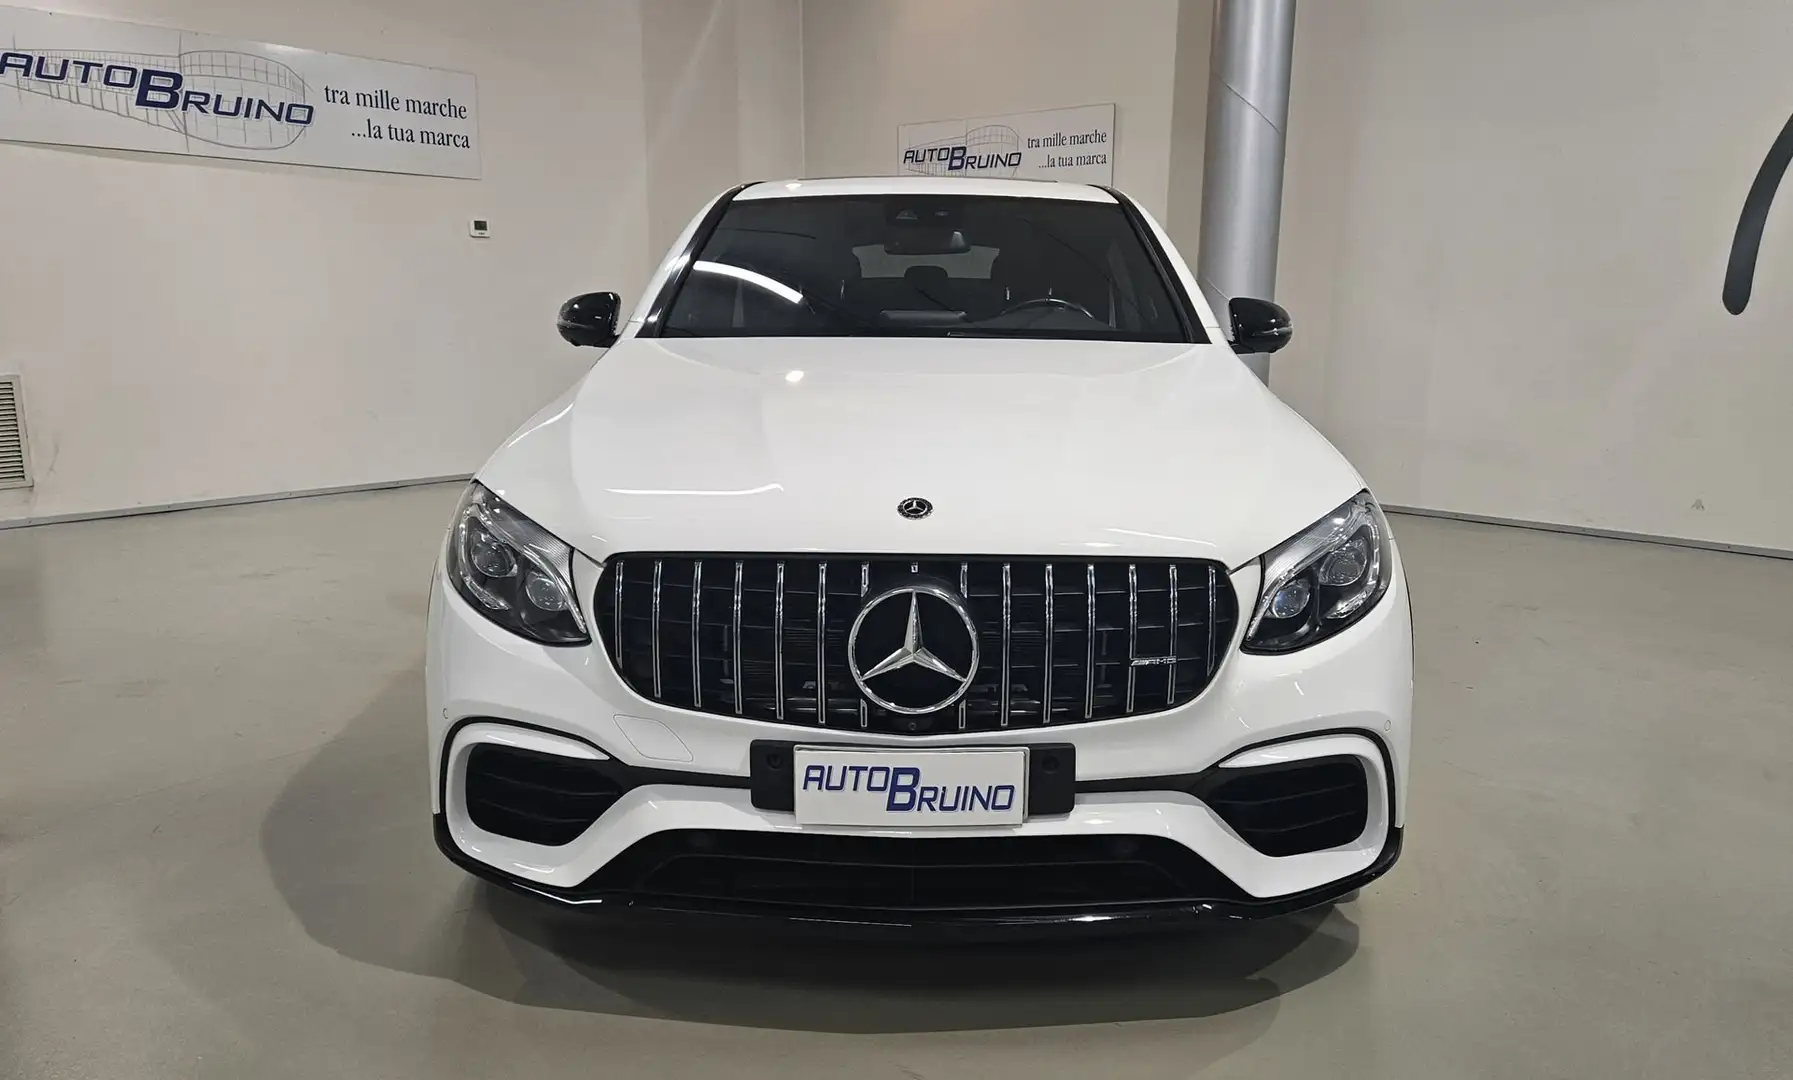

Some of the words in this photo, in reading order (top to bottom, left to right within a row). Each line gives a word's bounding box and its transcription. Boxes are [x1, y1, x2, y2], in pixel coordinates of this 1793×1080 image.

[324, 84, 350, 105] tra
[355, 89, 400, 111] mille
[405, 98, 468, 120] marche
[351, 118, 383, 140] ...la
[388, 123, 416, 143] tua
[420, 128, 471, 149] marca
[1027, 137, 1040, 149] tra
[1042, 131, 1067, 147] mille
[1069, 129, 1107, 146] marche
[1058, 155, 1074, 167] tua
[1076, 153, 1107, 166] marca
[802, 764, 1016, 812] AUTOBRUINO
